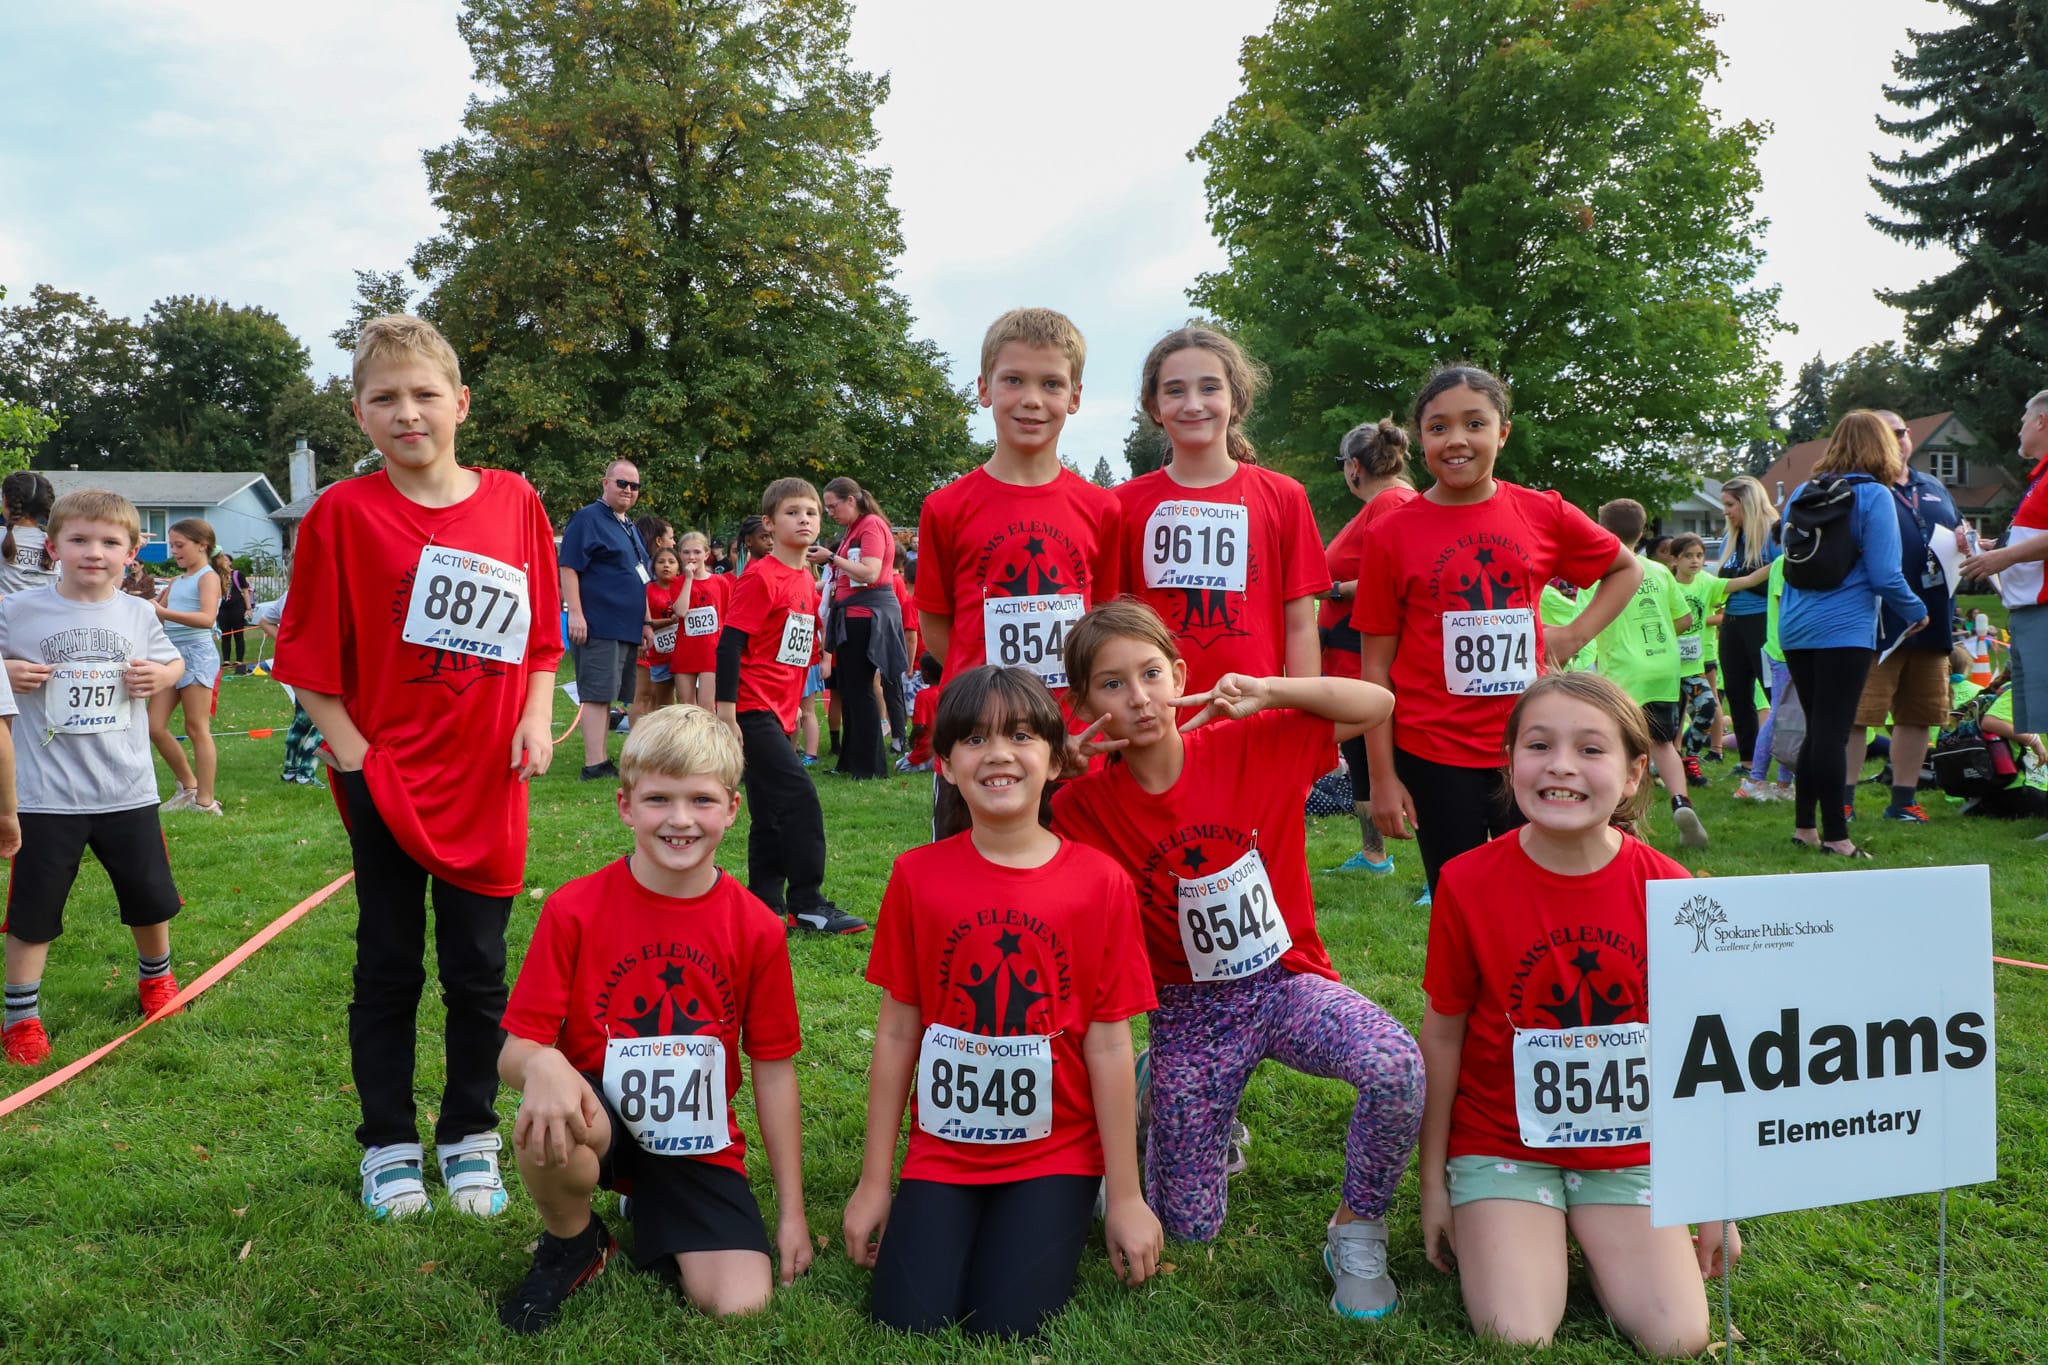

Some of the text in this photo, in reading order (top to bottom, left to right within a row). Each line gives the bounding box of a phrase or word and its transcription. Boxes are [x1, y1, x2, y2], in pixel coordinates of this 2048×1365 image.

[17, 556, 42, 566] YOUT
[1153, 524, 1236, 567] 9616
[1157, 569, 1228, 588] AVISTA
[1429, 543, 1456, 600] ADAMS
[424, 574, 520, 634] 8877
[1637, 585, 1659, 596] OUTH
[656, 630, 678, 648] 855
[687, 613, 715, 630] 9623
[424, 627, 503, 658] AVISTA
[999, 619, 1078, 666] 854
[1454, 633, 1529, 674] 8874
[69, 685, 116, 709] 3757
[1463, 678, 1526, 694] AVISTA
[63, 714, 117, 727] AVISTA
[1186, 882, 1277, 955] 8542
[1714, 919, 1834, 943] Spokane Public Schools
[938, 908, 1072, 1006] ADAMS ELEMENTARY
[1211, 941, 1280, 978] AVISTA
[1715, 940, 1795, 952] excellence for everyone
[594, 942, 737, 1031] ADAMS ELEMENTARY
[1509, 938, 1549, 1017] ADAMS
[1672, 1007, 1988, 1099] Adams
[620, 1068, 714, 1123] 8541
[930, 1058, 1037, 1117] 8548
[1533, 1056, 1650, 1115] 8545
[638, 1129, 715, 1151] AVISTA
[937, 1118, 1028, 1141] AVISTA
[1546, 1121, 1643, 1143] AVISTA
[1757, 1108, 1921, 1147] Elementary
